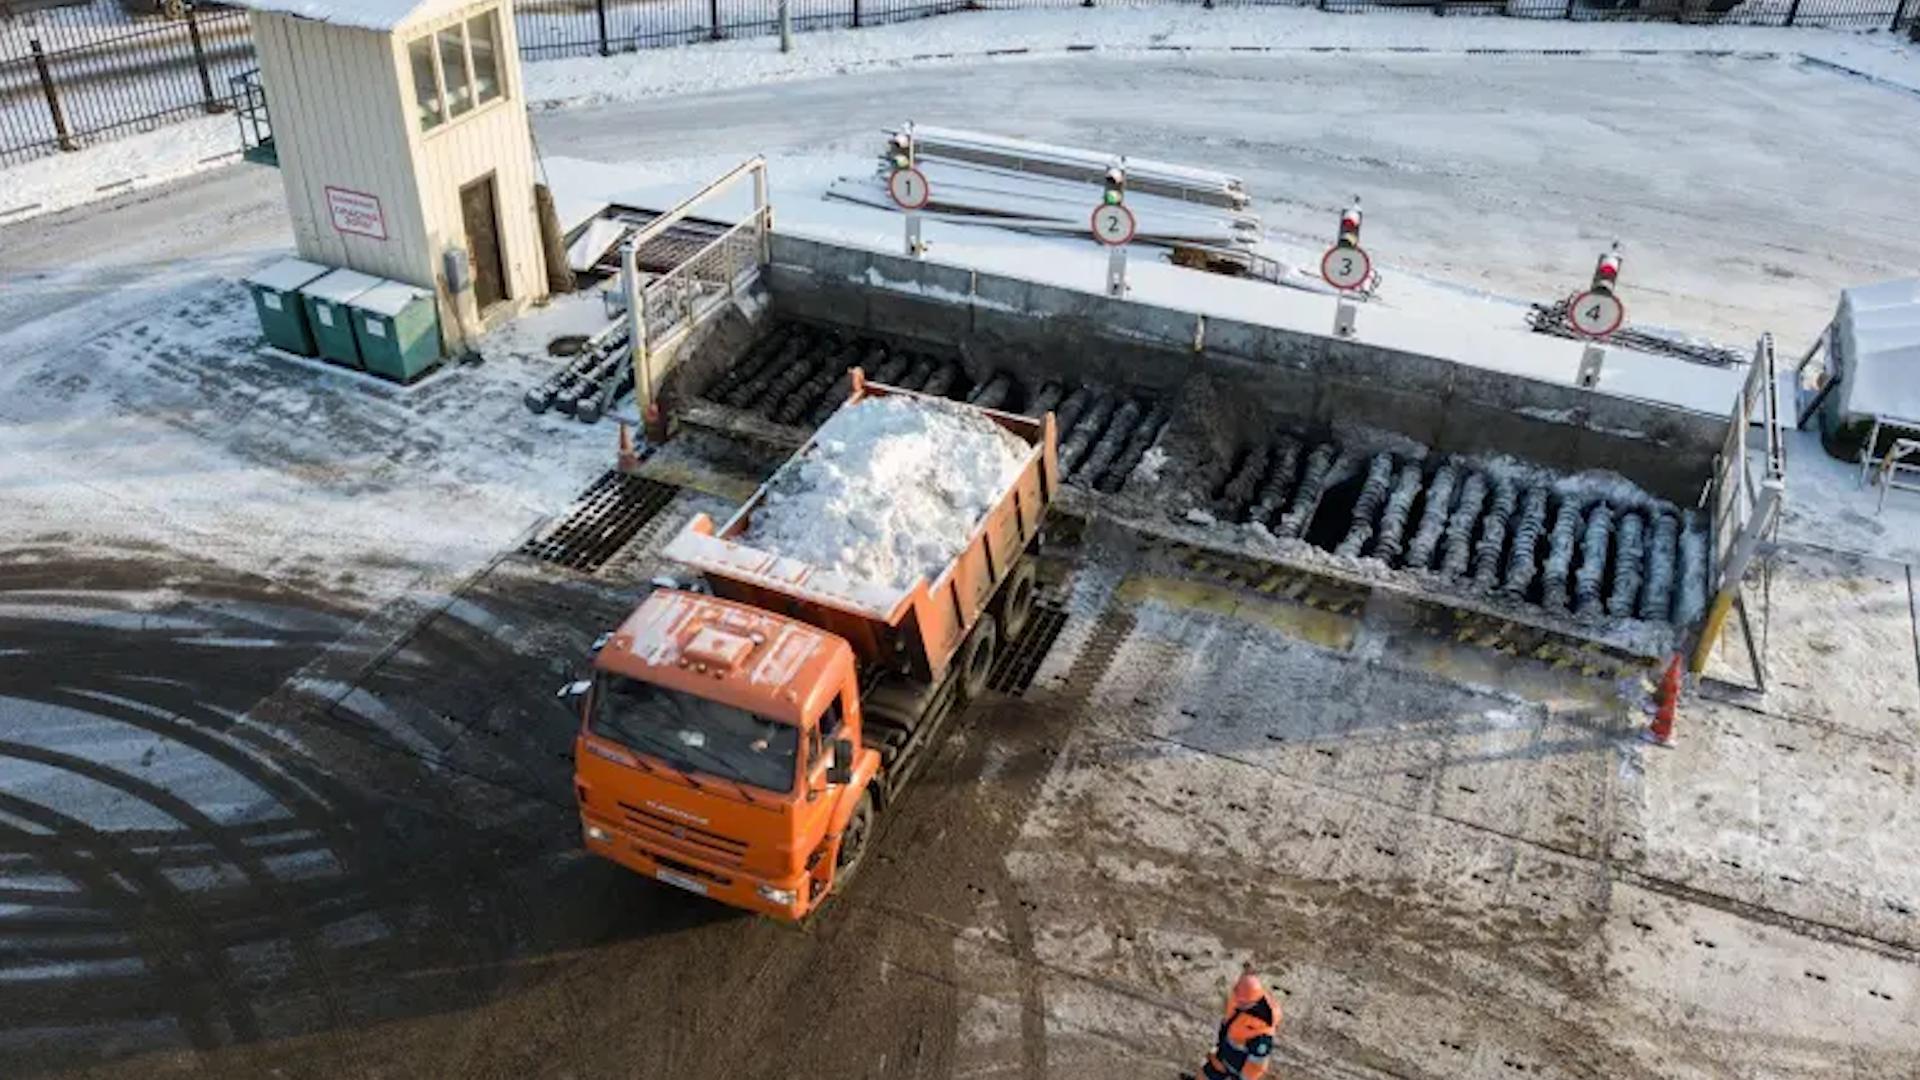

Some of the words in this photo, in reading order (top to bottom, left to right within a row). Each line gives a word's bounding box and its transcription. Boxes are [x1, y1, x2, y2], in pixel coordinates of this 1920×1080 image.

[904, 180, 911, 196] 1
[1108, 216, 1120, 232] 2
[1339, 257, 1352, 276] 3
[1585, 303, 1601, 321] 4
